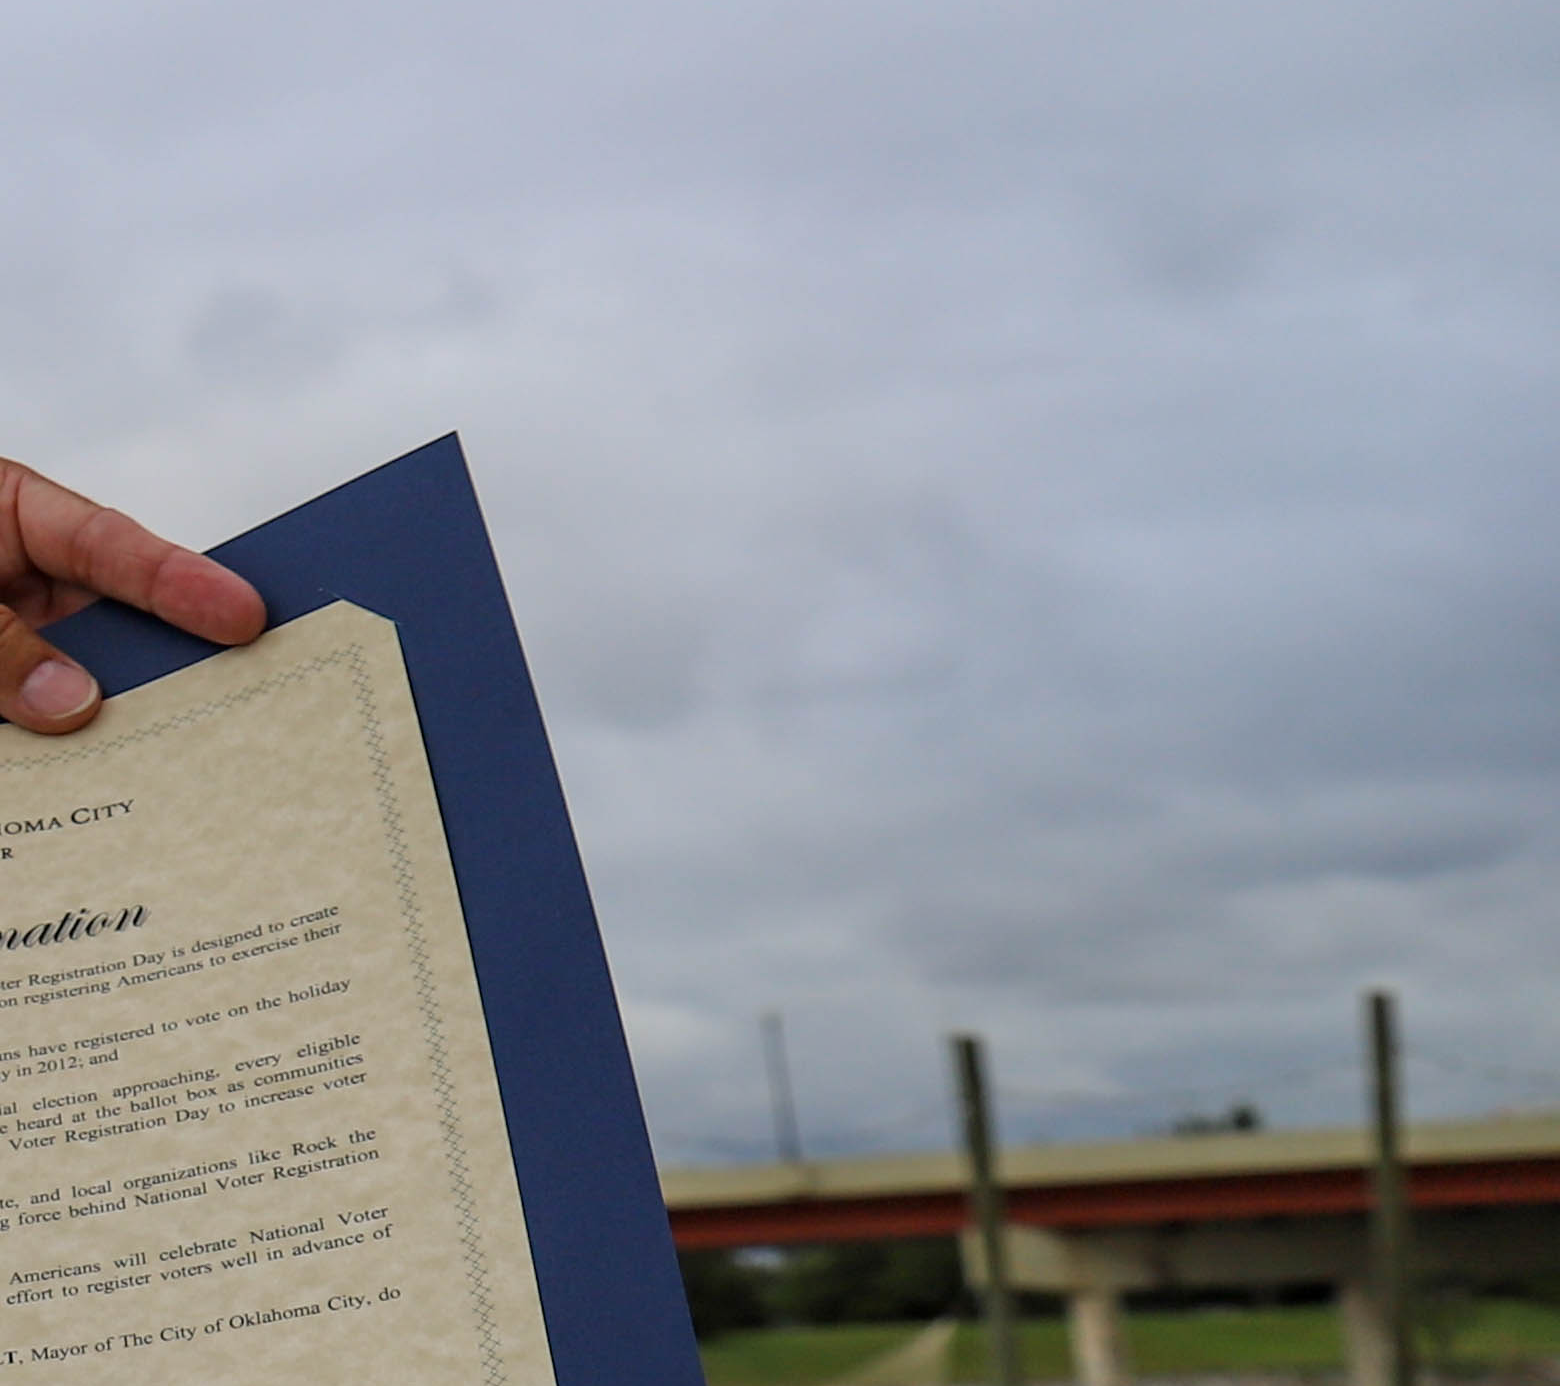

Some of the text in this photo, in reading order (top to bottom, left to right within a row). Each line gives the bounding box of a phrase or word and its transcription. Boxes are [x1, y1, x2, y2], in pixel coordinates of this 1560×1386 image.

[28, 961, 127, 987] Registration
[132, 952, 165, 967] Day
[171, 948, 186, 958] is
[191, 924, 264, 954] designed
[268, 922, 285, 934] to
[289, 905, 339, 928] create
[30, 1187, 61, 1205] and
[71, 1180, 112, 1199] local
[123, 1159, 238, 1191] organizations
[248, 1149, 281, 1165] like
[291, 1135, 338, 1157] Rock
[348, 1129, 376, 1145] the
[6, 1288, 53, 1305] effort
[61, 1286, 79, 1298] to
[86, 1274, 152, 1295] register
[160, 1263, 213, 1281] voters
[220, 1250, 258, 1270] well
[266, 1249, 284, 1262] in
[292, 1233, 365, 1257] advance
[372, 1223, 394, 1240] of
[9, 1262, 102, 1286] Americans
[113, 1251, 147, 1269] will
[159, 1238, 238, 1262] celebrate
[248, 1217, 325, 1245] National
[337, 1207, 389, 1226] Voter
[31, 1344, 89, 1362] Mayor
[94, 1336, 115, 1353] of
[119, 1332, 153, 1349] The
[159, 1326, 197, 1342] City
[203, 1317, 225, 1335] of
[228, 1304, 321, 1330] Oklahoma
[327, 1295, 372, 1312] City,
[378, 1286, 401, 1302] do
